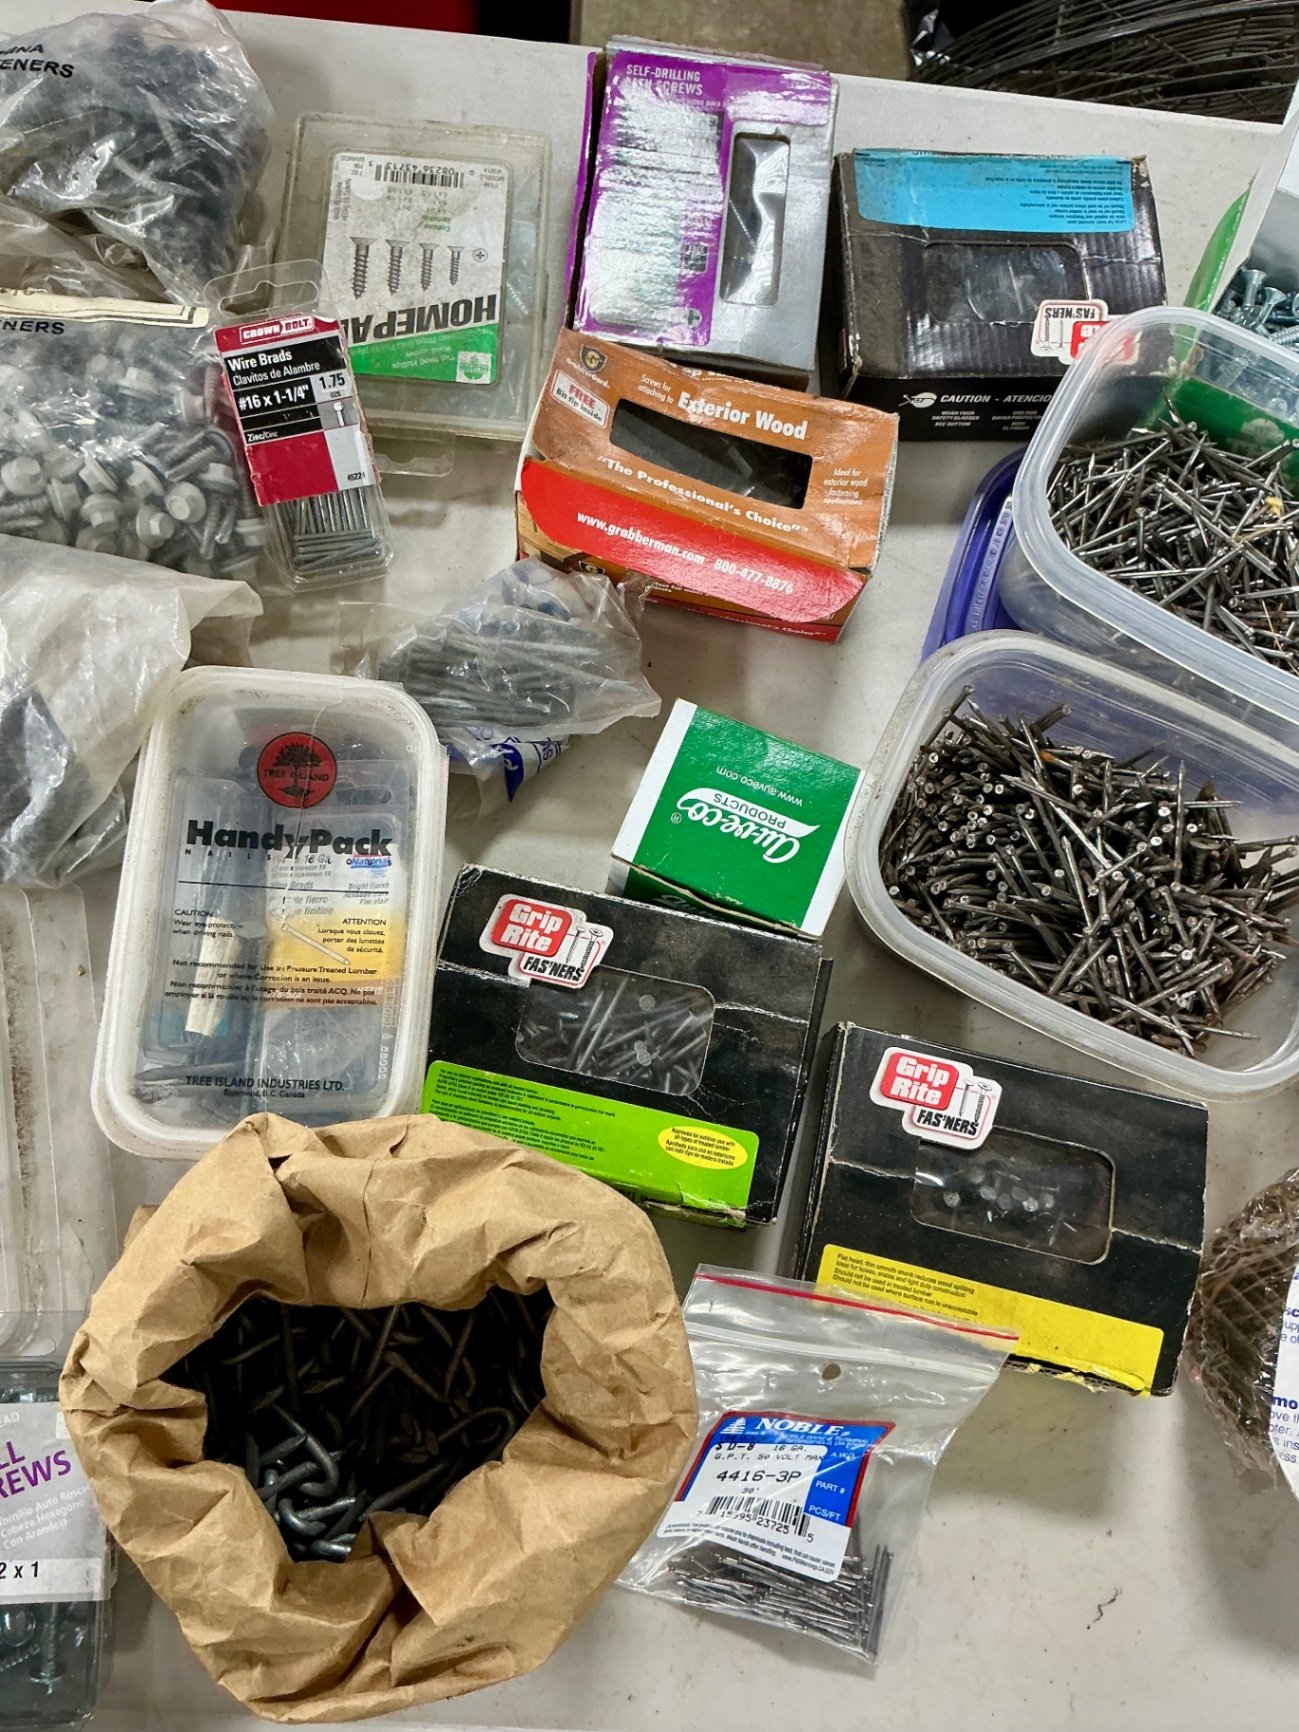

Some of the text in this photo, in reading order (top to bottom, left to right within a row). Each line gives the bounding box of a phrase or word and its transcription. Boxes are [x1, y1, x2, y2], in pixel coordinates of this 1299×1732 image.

[626, 64, 701, 82] SELF-DRILLING
[656, 80, 703, 96] SCREWS
[1045, 307, 1096, 319] FAS'NERS
[240, 317, 310, 340] CROWN BOLT
[227, 347, 293, 372] Wire Brads
[232, 358, 321, 386] Clavitos de Alambre
[317, 371, 346, 390] 1.75
[641, 374, 672, 392] Screws for
[236, 382, 311, 412] #16 x 1-1/4"
[568, 384, 597, 410] FREE
[638, 385, 674, 405] attaching to
[940, 395, 991, 403] CAUTION
[556, 388, 568, 401] Bit
[580, 402, 603, 422] inside
[677, 391, 808, 440] Exterior Wood
[637, 470, 741, 516] Professional's
[577, 511, 795, 594] www.grabberman.com 800-477-8876
[716, 766, 803, 807] www.auveco.com
[713, 793, 787, 829] PRODUCTS
[173, 908, 213, 917] CAUTION
[341, 916, 386, 926] ATTENTION
[509, 903, 563, 934] Grip
[173, 918, 192, 926] Wear
[194, 920, 206, 928] eye
[317, 926, 344, 937] Lorsque
[192, 929, 216, 938] driving
[322, 936, 384, 945] porter des lunettes
[501, 923, 553, 952] Rite
[172, 959, 188, 967] Not
[189, 962, 246, 970] recommended
[318, 966, 347, 974] Treated
[348, 967, 378, 975] Lumber
[523, 956, 585, 982] FAS'NERS
[229, 972, 253, 980] where
[254, 974, 292, 982] Corrosion
[170, 980, 186, 988] Non
[290, 986, 306, 994] bois
[307, 986, 328, 994] traité
[328, 987, 349, 996] ACQ.
[350, 988, 361, 996] Ne
[362, 989, 375, 998] pas
[164, 991, 200, 1000] employer
[260, 996, 298, 1004] corrosion
[307, 997, 322, 1005] sont
[323, 998, 335, 1006] pas
[896, 1056, 950, 1087] Grip
[186, 1075, 345, 1091] TREE ISLAND INDUSTRIES LTD.
[890, 1076, 942, 1106] Rite
[279, 1090, 306, 1098] Canada
[917, 1109, 979, 1136] FAS'NERS
[836, 1252, 937, 1285] Flat smooth reduces
[831, 1273, 924, 1304] Should not be used where surface
[833, 1266, 933, 1299] Should not be used treated lumber
[894, 1274, 932, 1291] and light duty
[755, 1418, 844, 1436] NOBLE
[757, 1453, 771, 1461] 50
[776, 1453, 801, 1461] VOLT
[773, 1444, 785, 1452] 16
[716, 1470, 802, 1482] 4416-3P
[815, 1480, 838, 1493] PART
[36, 1497, 59, 1512] Auto
[808, 1504, 842, 1521] PCS/FT
[0, 1499, 86, 1538] Cabeza Hexagono
[3, 1517, 68, 1550] Con Arandela
[755, 1517, 790, 1535] 23725
[806, 1533, 815, 1543] 5
[14, 1565, 23, 1579] x
[31, 1561, 39, 1578] 1
